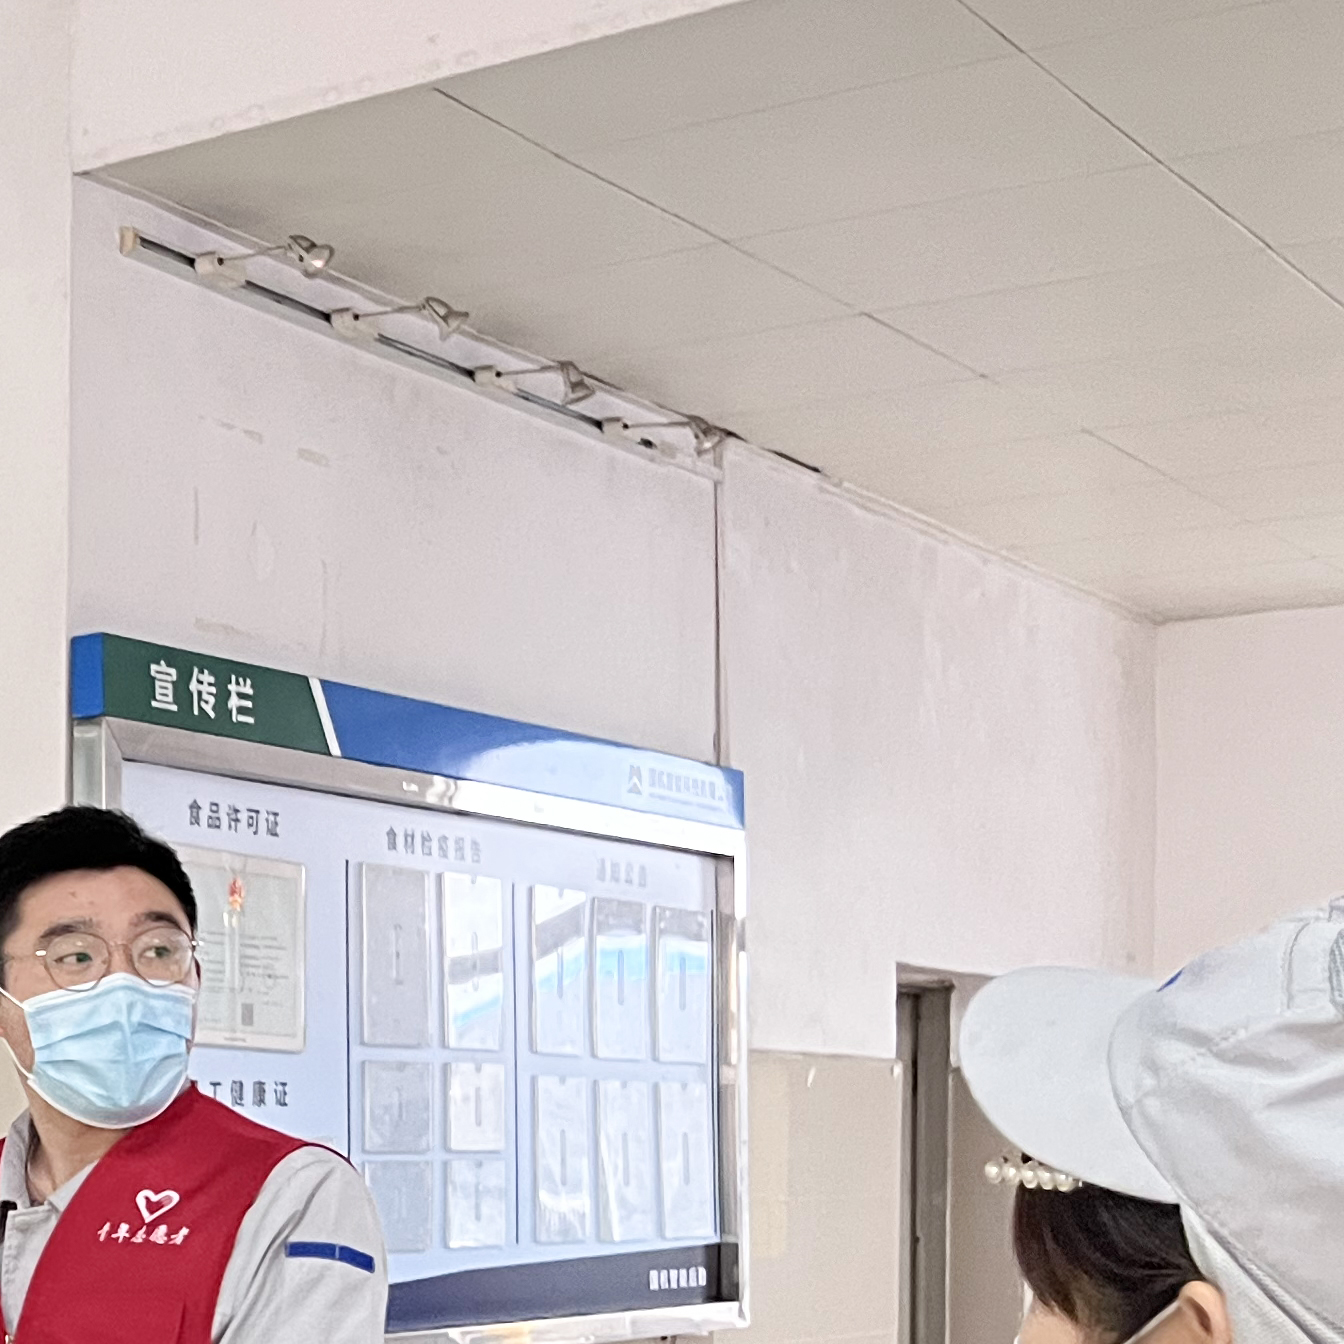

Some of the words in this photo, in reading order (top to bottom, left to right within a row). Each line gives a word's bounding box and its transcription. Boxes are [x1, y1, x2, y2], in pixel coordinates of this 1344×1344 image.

[149, 659, 255, 725] 宣传栏
[188, 798, 280, 838] 食品许可证
[188, 1079, 289, 1109] 工健康证
